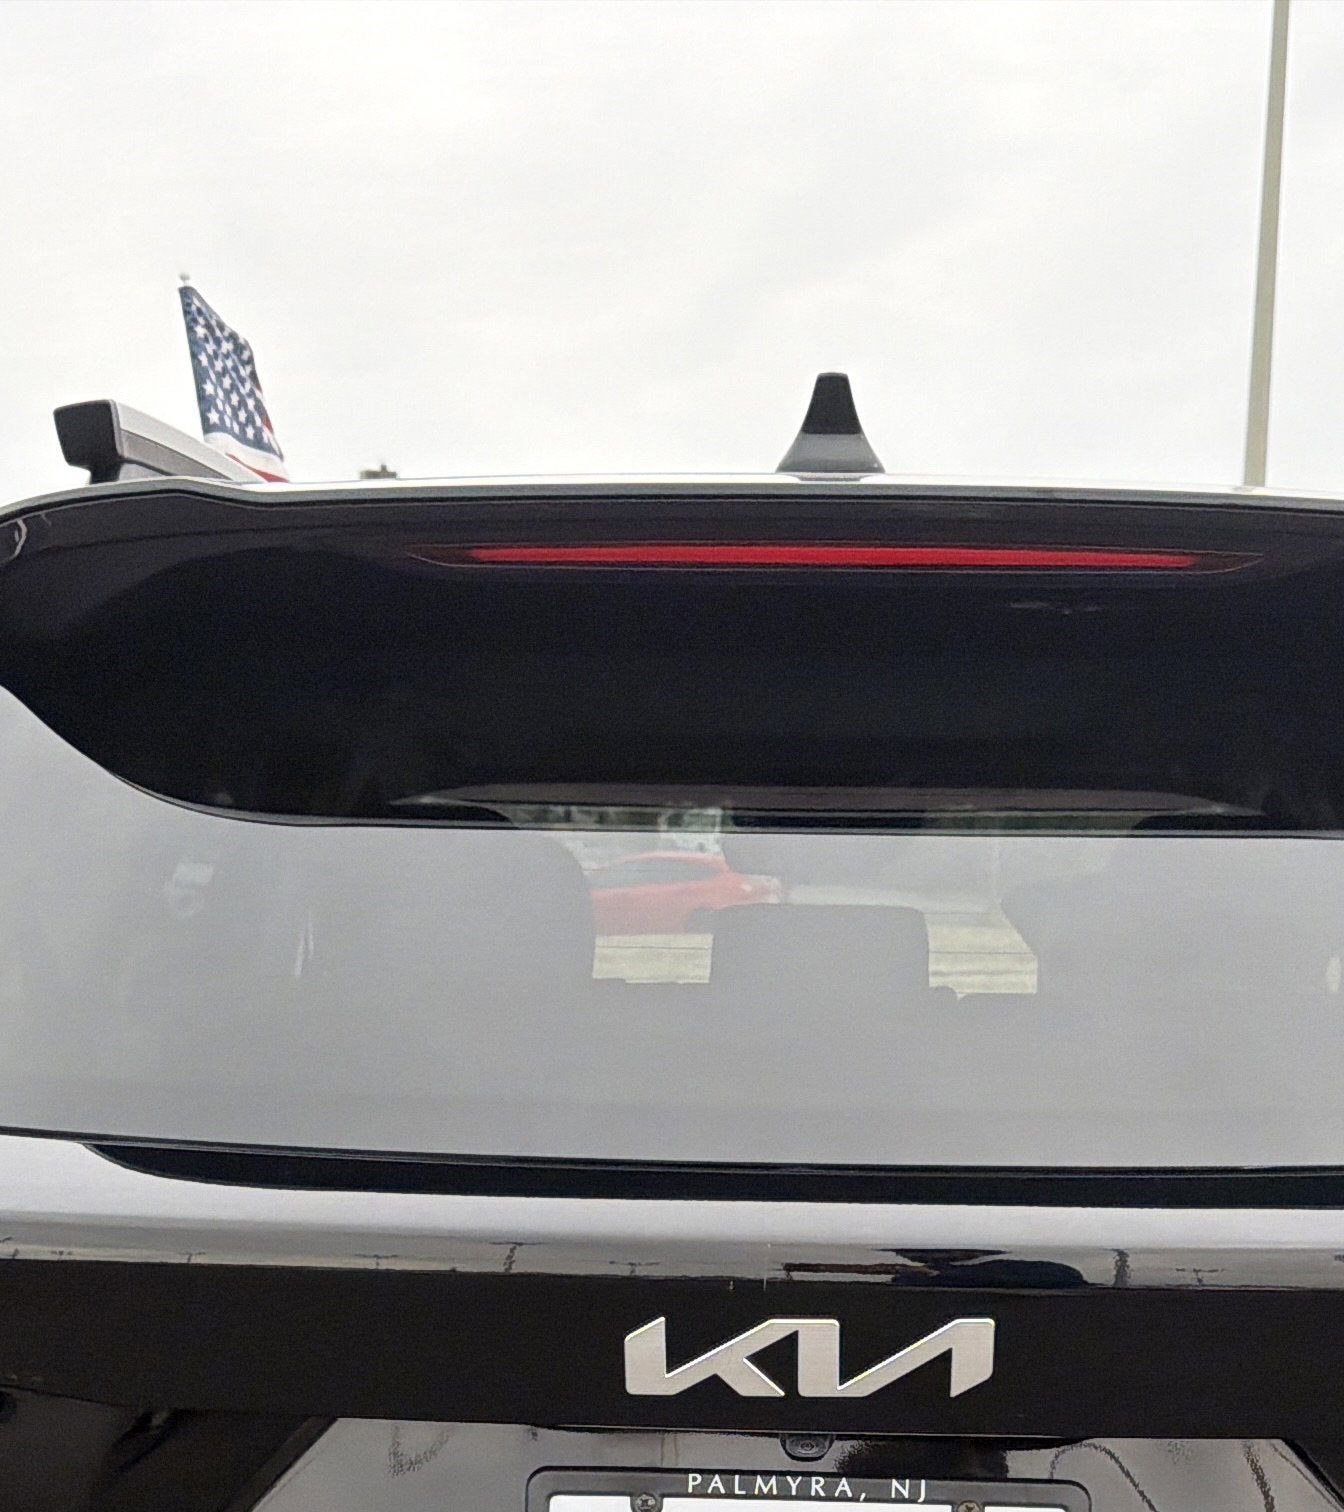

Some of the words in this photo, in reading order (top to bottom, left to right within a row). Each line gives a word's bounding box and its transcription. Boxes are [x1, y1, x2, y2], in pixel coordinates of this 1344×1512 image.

[624, 1316, 996, 1398] KIA
[687, 1473, 866, 1502] PALMYRA,
[891, 1478, 927, 1503] NJ
